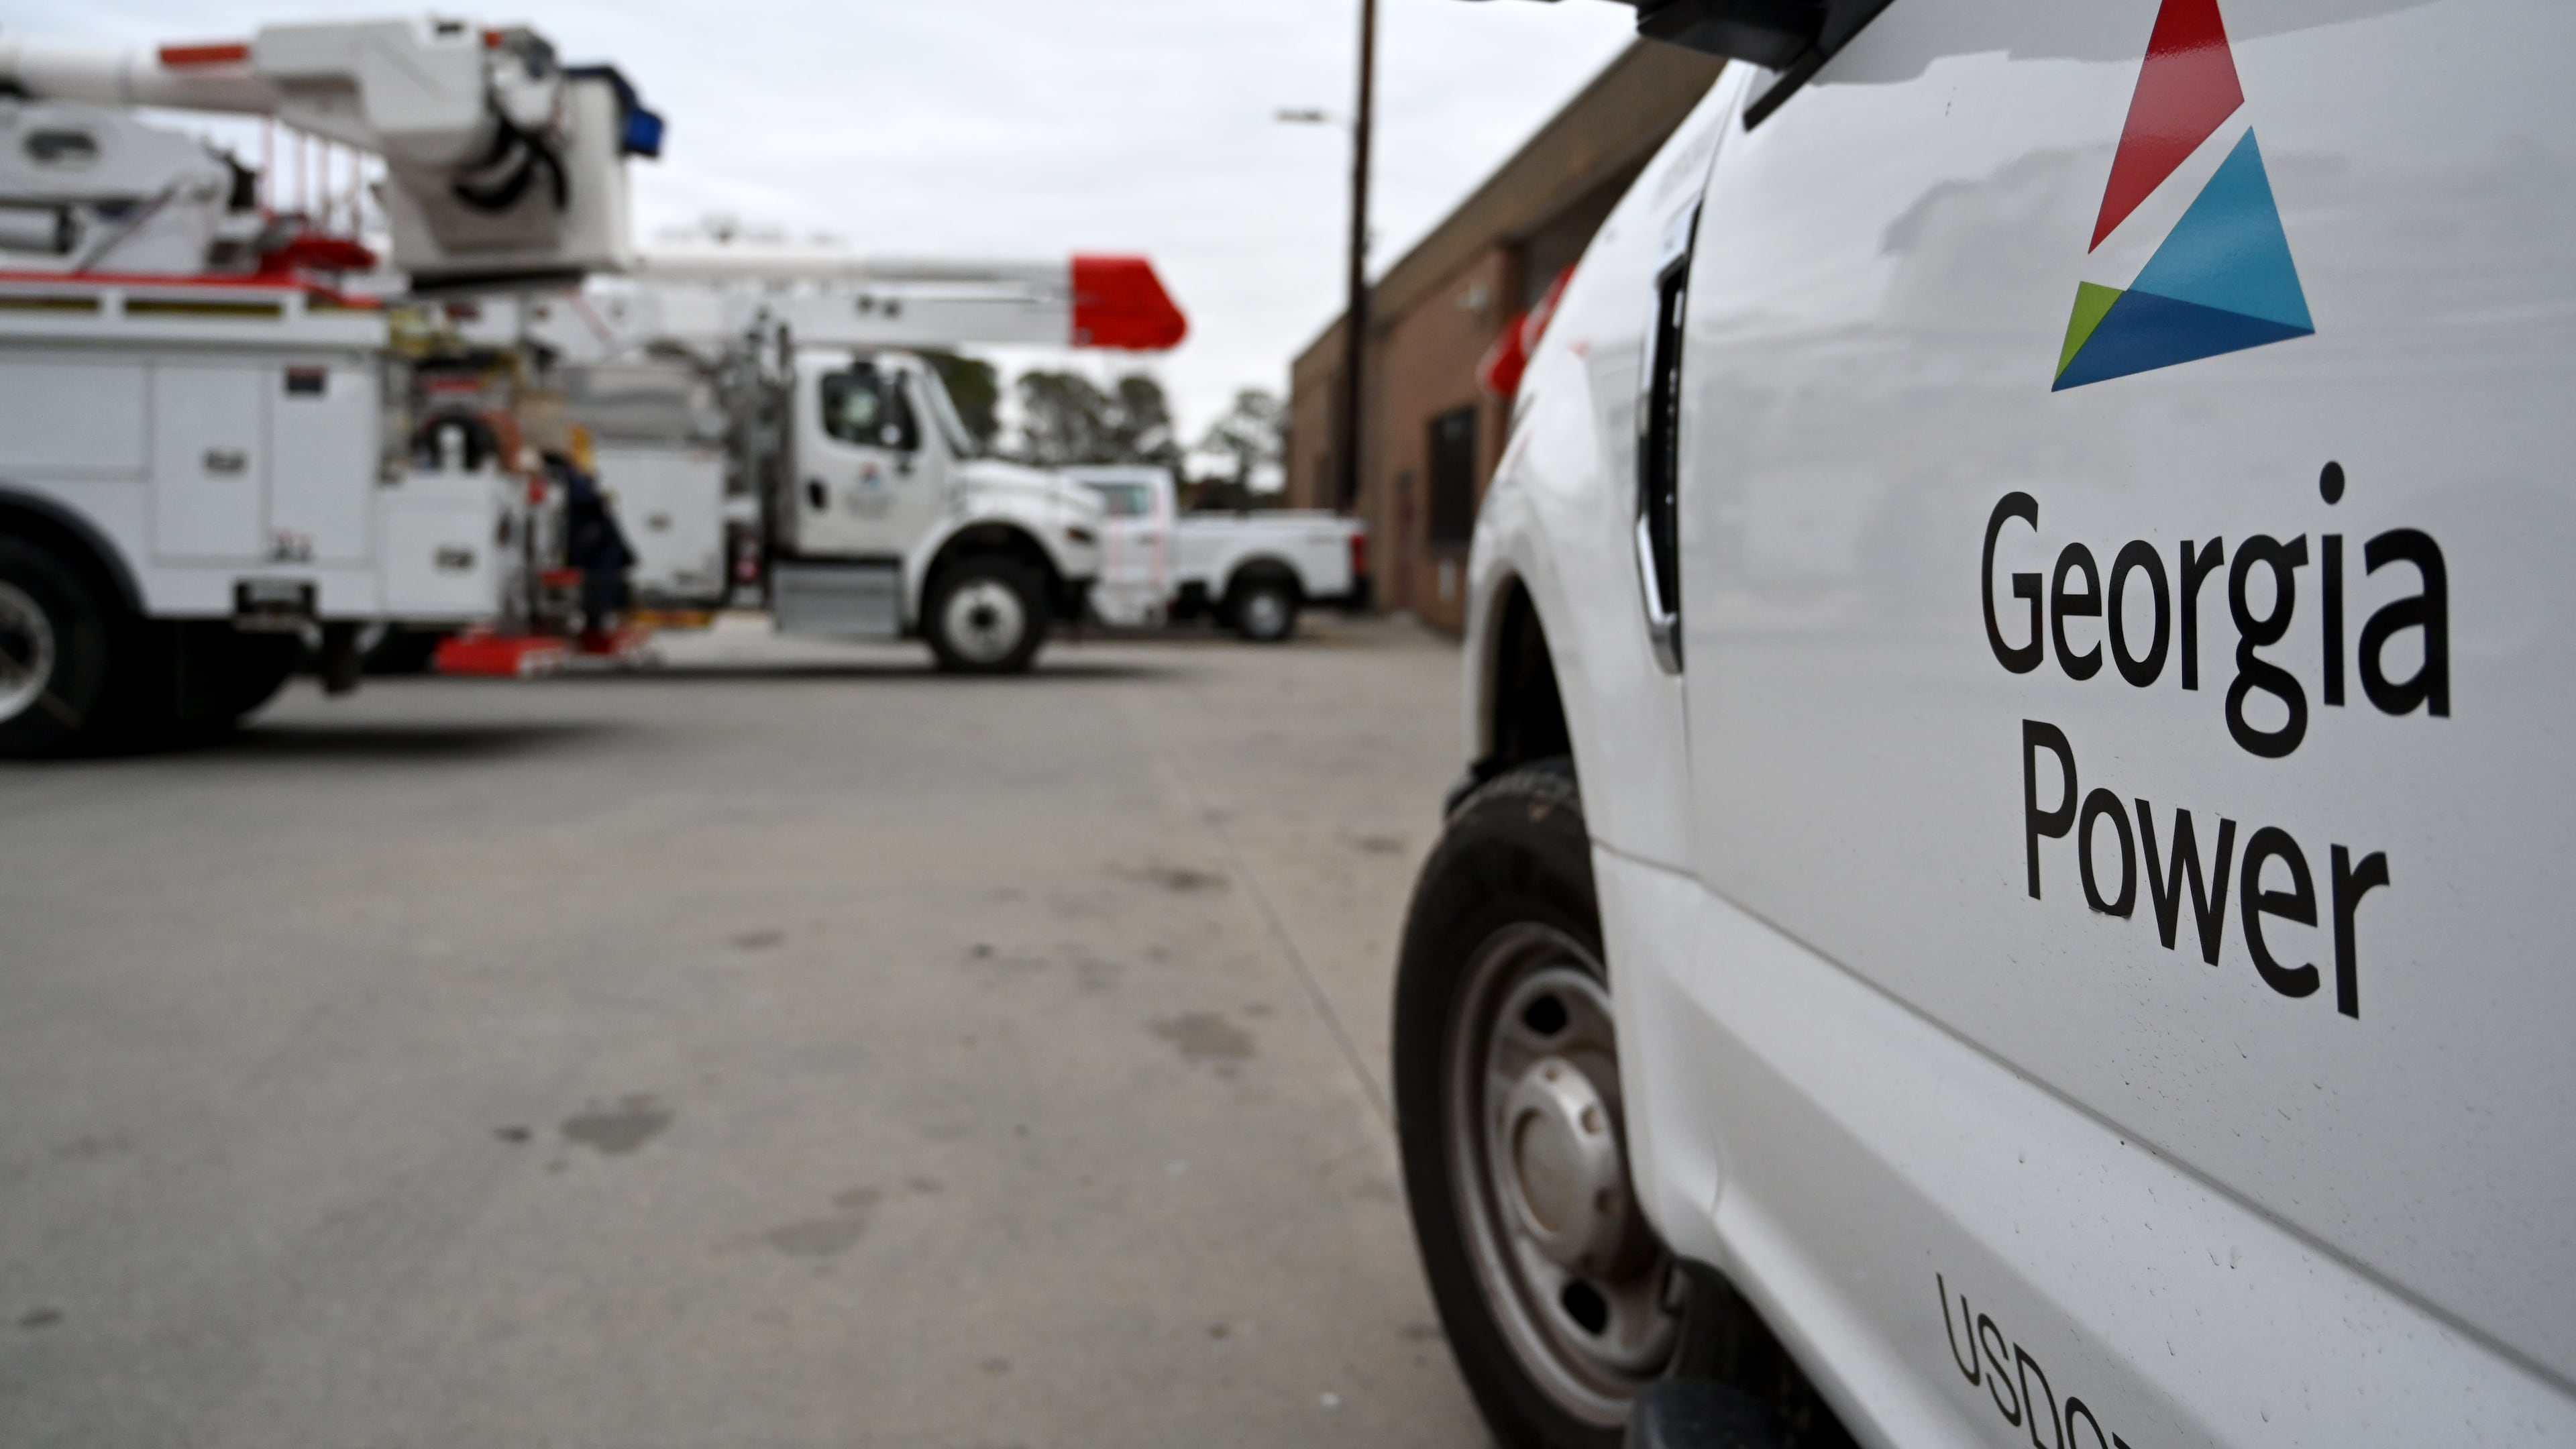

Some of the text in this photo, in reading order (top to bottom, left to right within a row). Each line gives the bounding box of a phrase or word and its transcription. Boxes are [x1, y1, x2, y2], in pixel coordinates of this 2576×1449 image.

[1982, 461, 2451, 759] Georgia
[2022, 718, 2390, 1020] Power
[1936, 1273, 2133, 1449] USD
